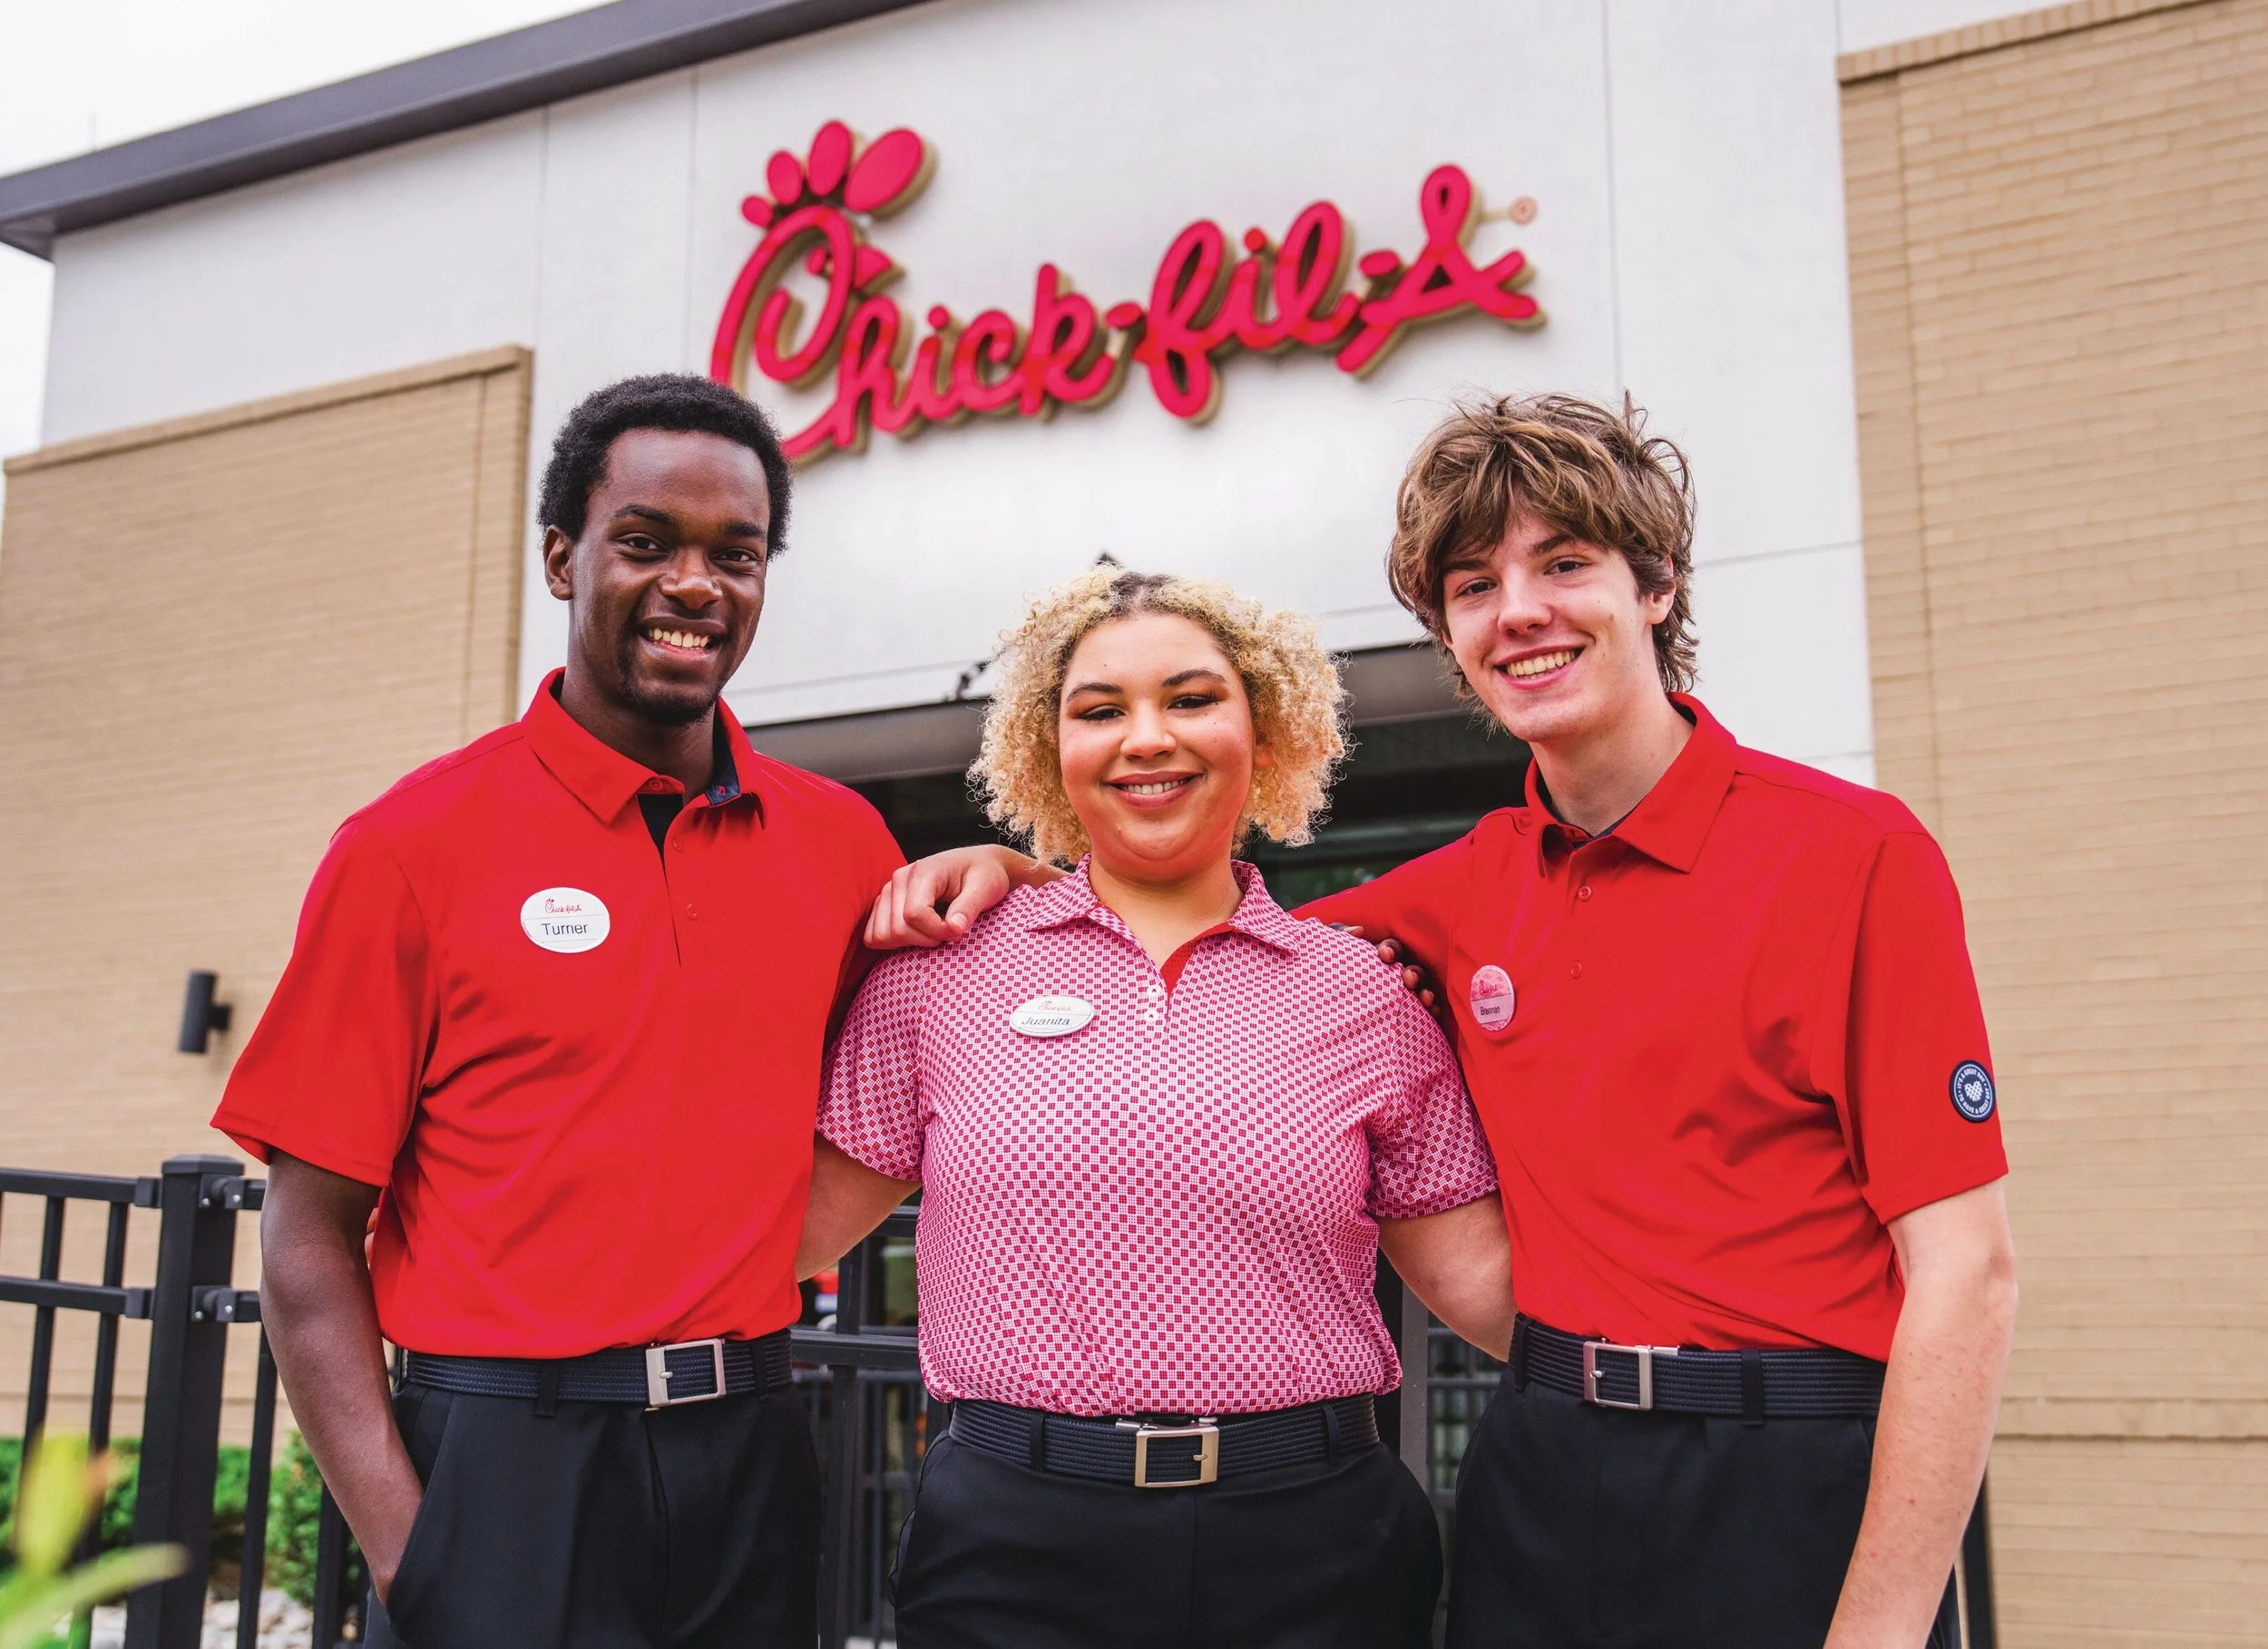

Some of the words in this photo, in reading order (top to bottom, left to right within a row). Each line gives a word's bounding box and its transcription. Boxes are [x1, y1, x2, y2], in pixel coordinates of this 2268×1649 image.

[709, 120, 1544, 461] Chick-fil-A
[541, 922, 589, 936] Turner
[1022, 1016, 1070, 1026] Juanita
